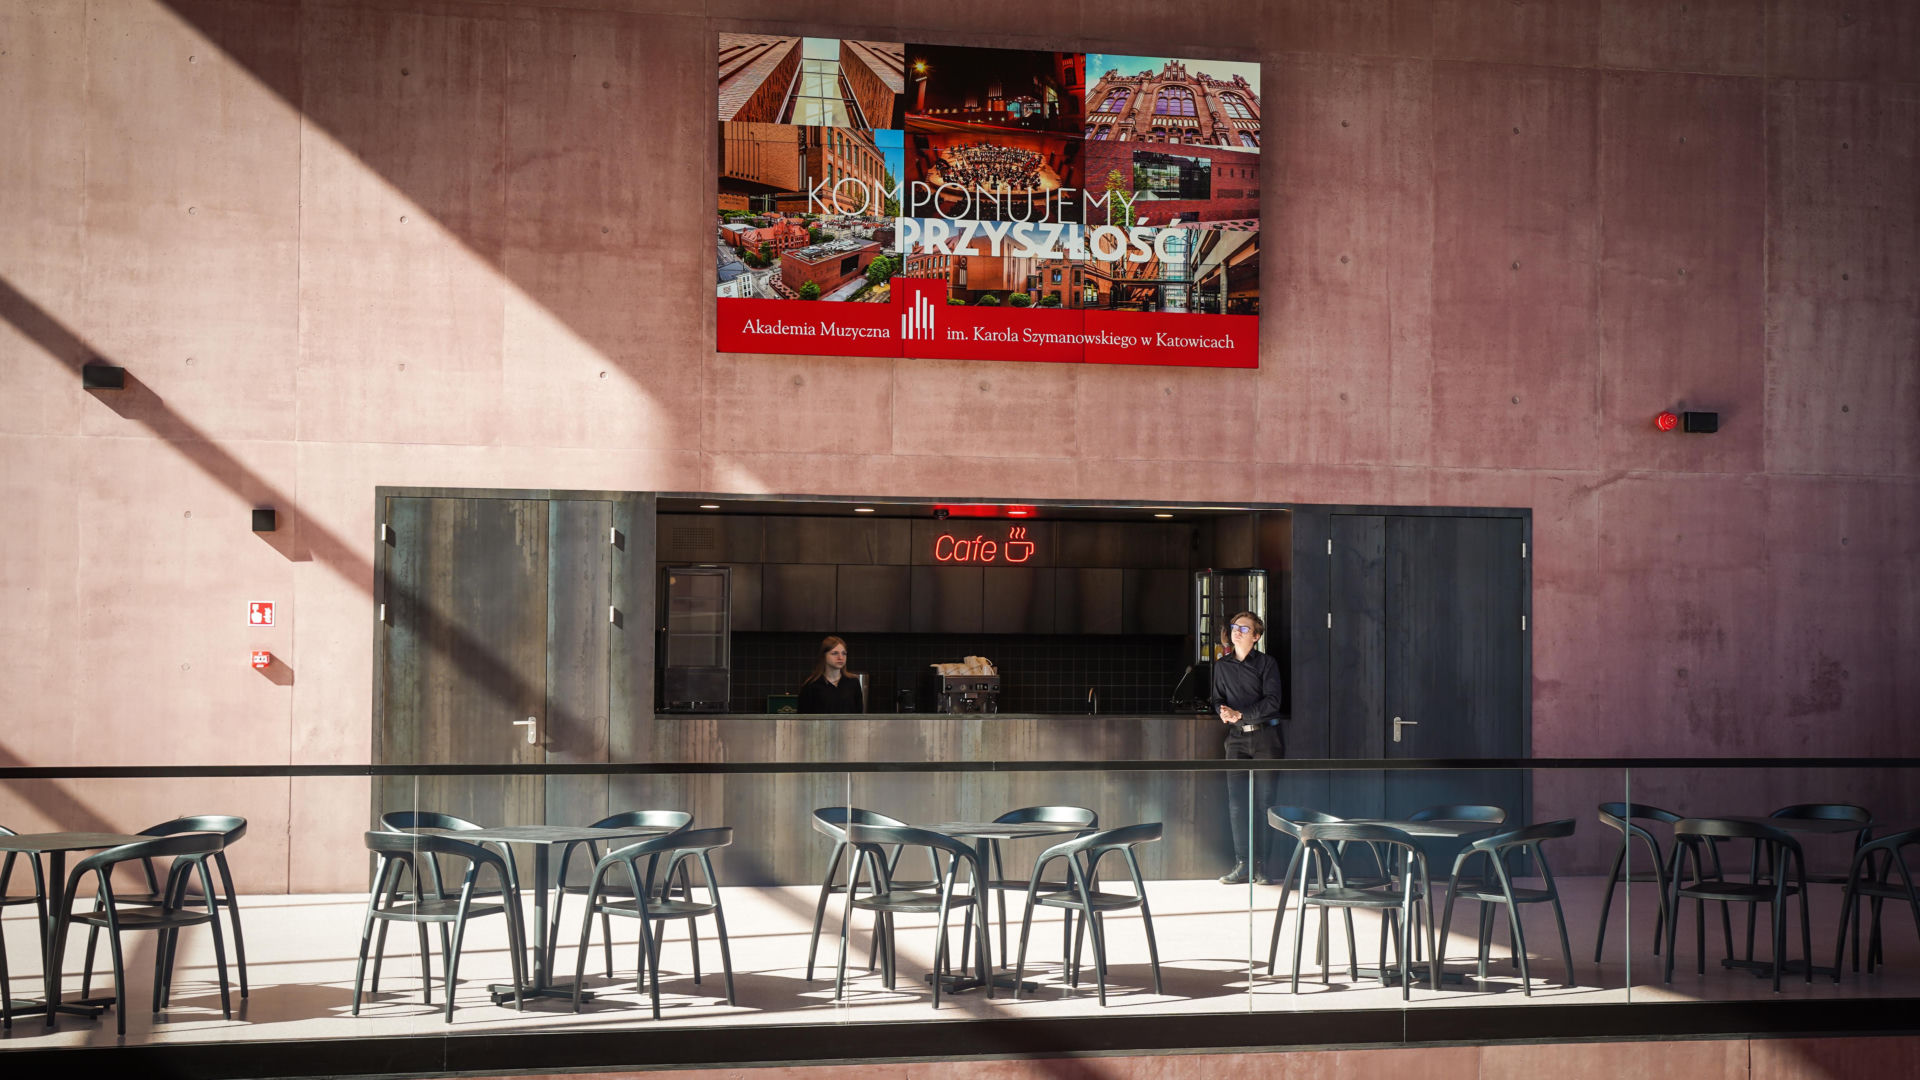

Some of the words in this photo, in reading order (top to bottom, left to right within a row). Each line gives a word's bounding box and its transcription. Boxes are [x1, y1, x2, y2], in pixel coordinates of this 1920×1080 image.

[808, 176, 1139, 227] KOMPONUJEMY
[895, 217, 1187, 263] PRZYSZŁOŚĆ
[742, 319, 816, 336] Akademia
[821, 322, 890, 340] Muzyczna
[947, 327, 968, 341] im.
[973, 327, 1018, 342] Karola
[1023, 328, 1137, 349] Szymanowskiego
[1141, 337, 1152, 346] w
[1156, 333, 1235, 349] Katowicach
[935, 534, 997, 562] Cafe
